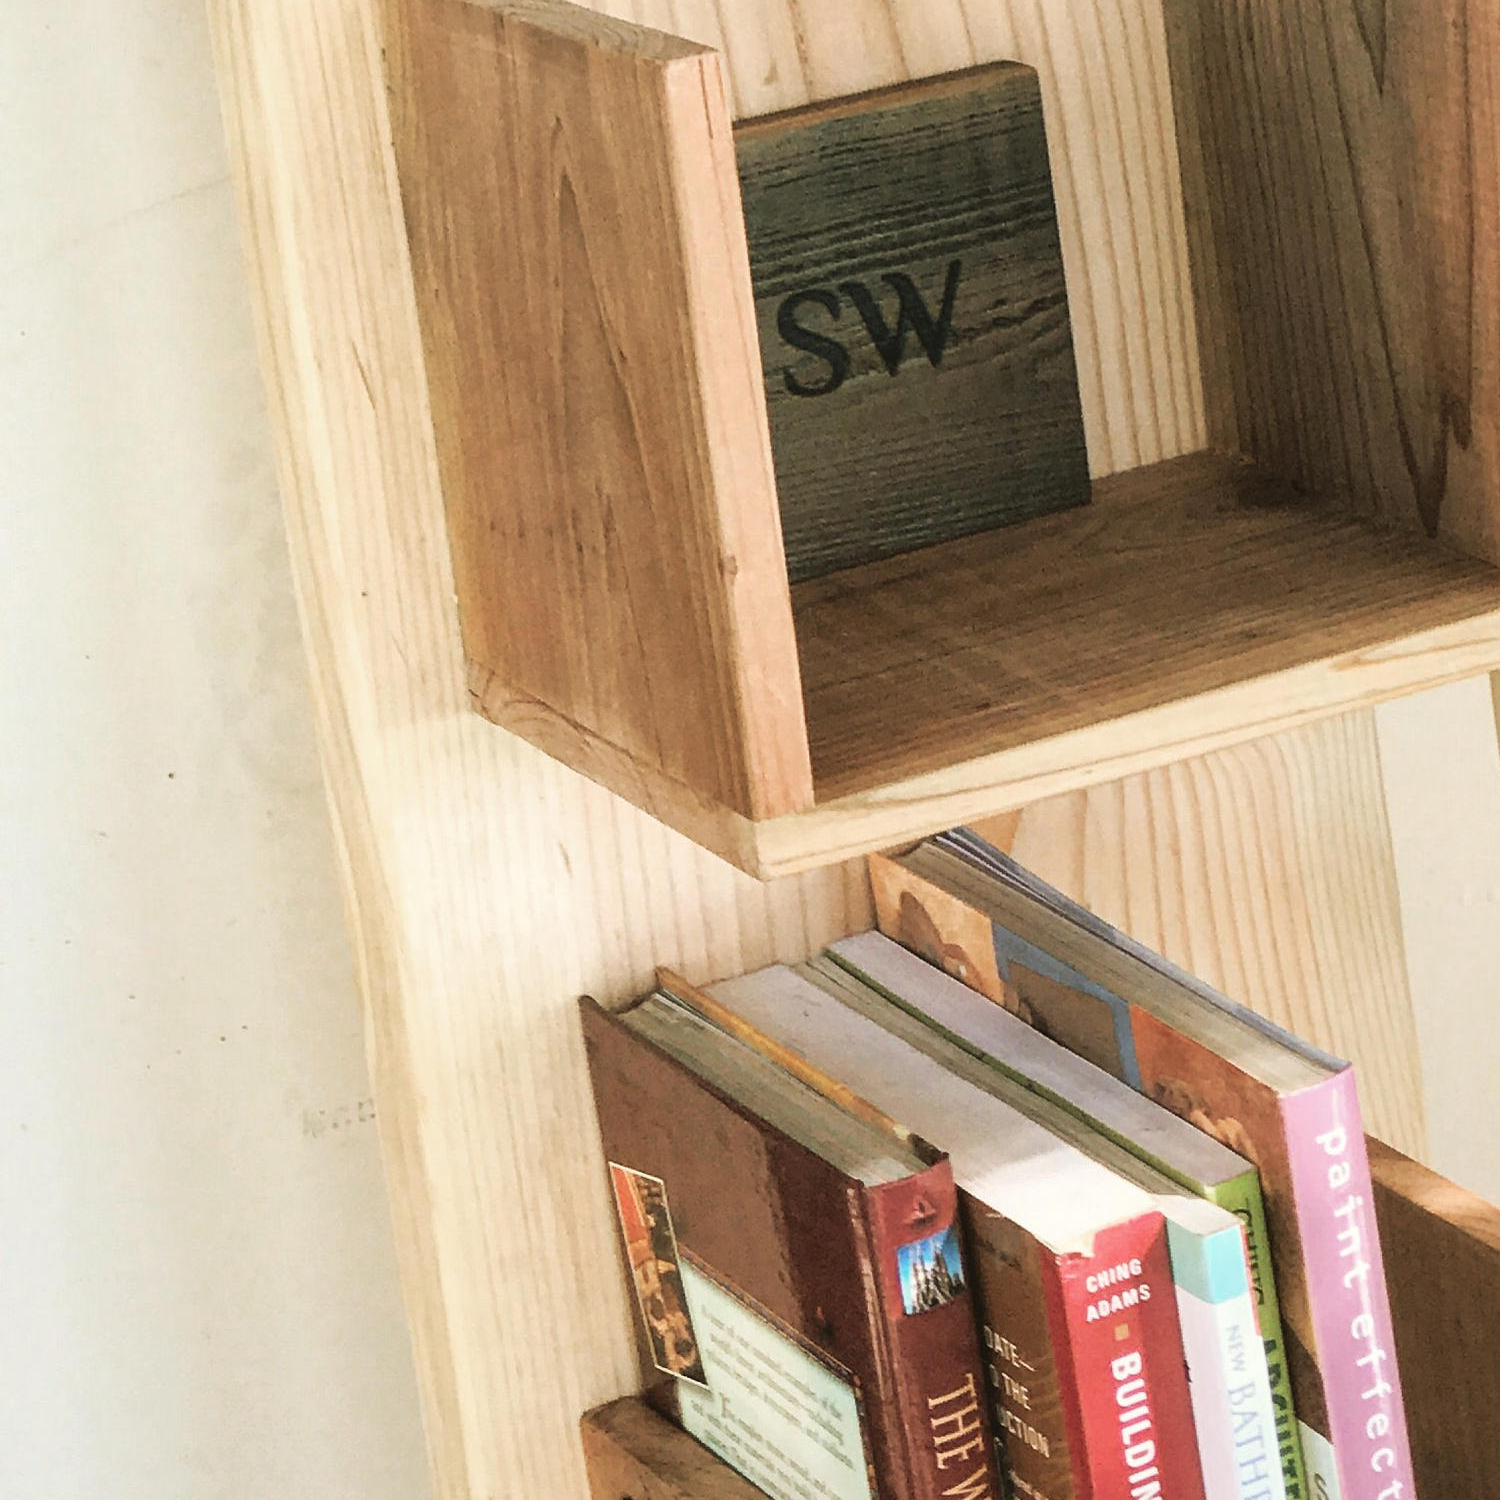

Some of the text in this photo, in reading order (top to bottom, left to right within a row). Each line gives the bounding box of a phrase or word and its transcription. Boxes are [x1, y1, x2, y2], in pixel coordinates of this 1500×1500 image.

[776, 258, 962, 398] SW
[1315, 1126, 1371, 1290] paint
[1086, 1258, 1143, 1294] CHING
[1086, 1284, 1151, 1323] ADAMS
[1225, 1324, 1248, 1373] NEW
[1002, 1372, 1032, 1411] THE
[928, 1373, 985, 1469] THE
